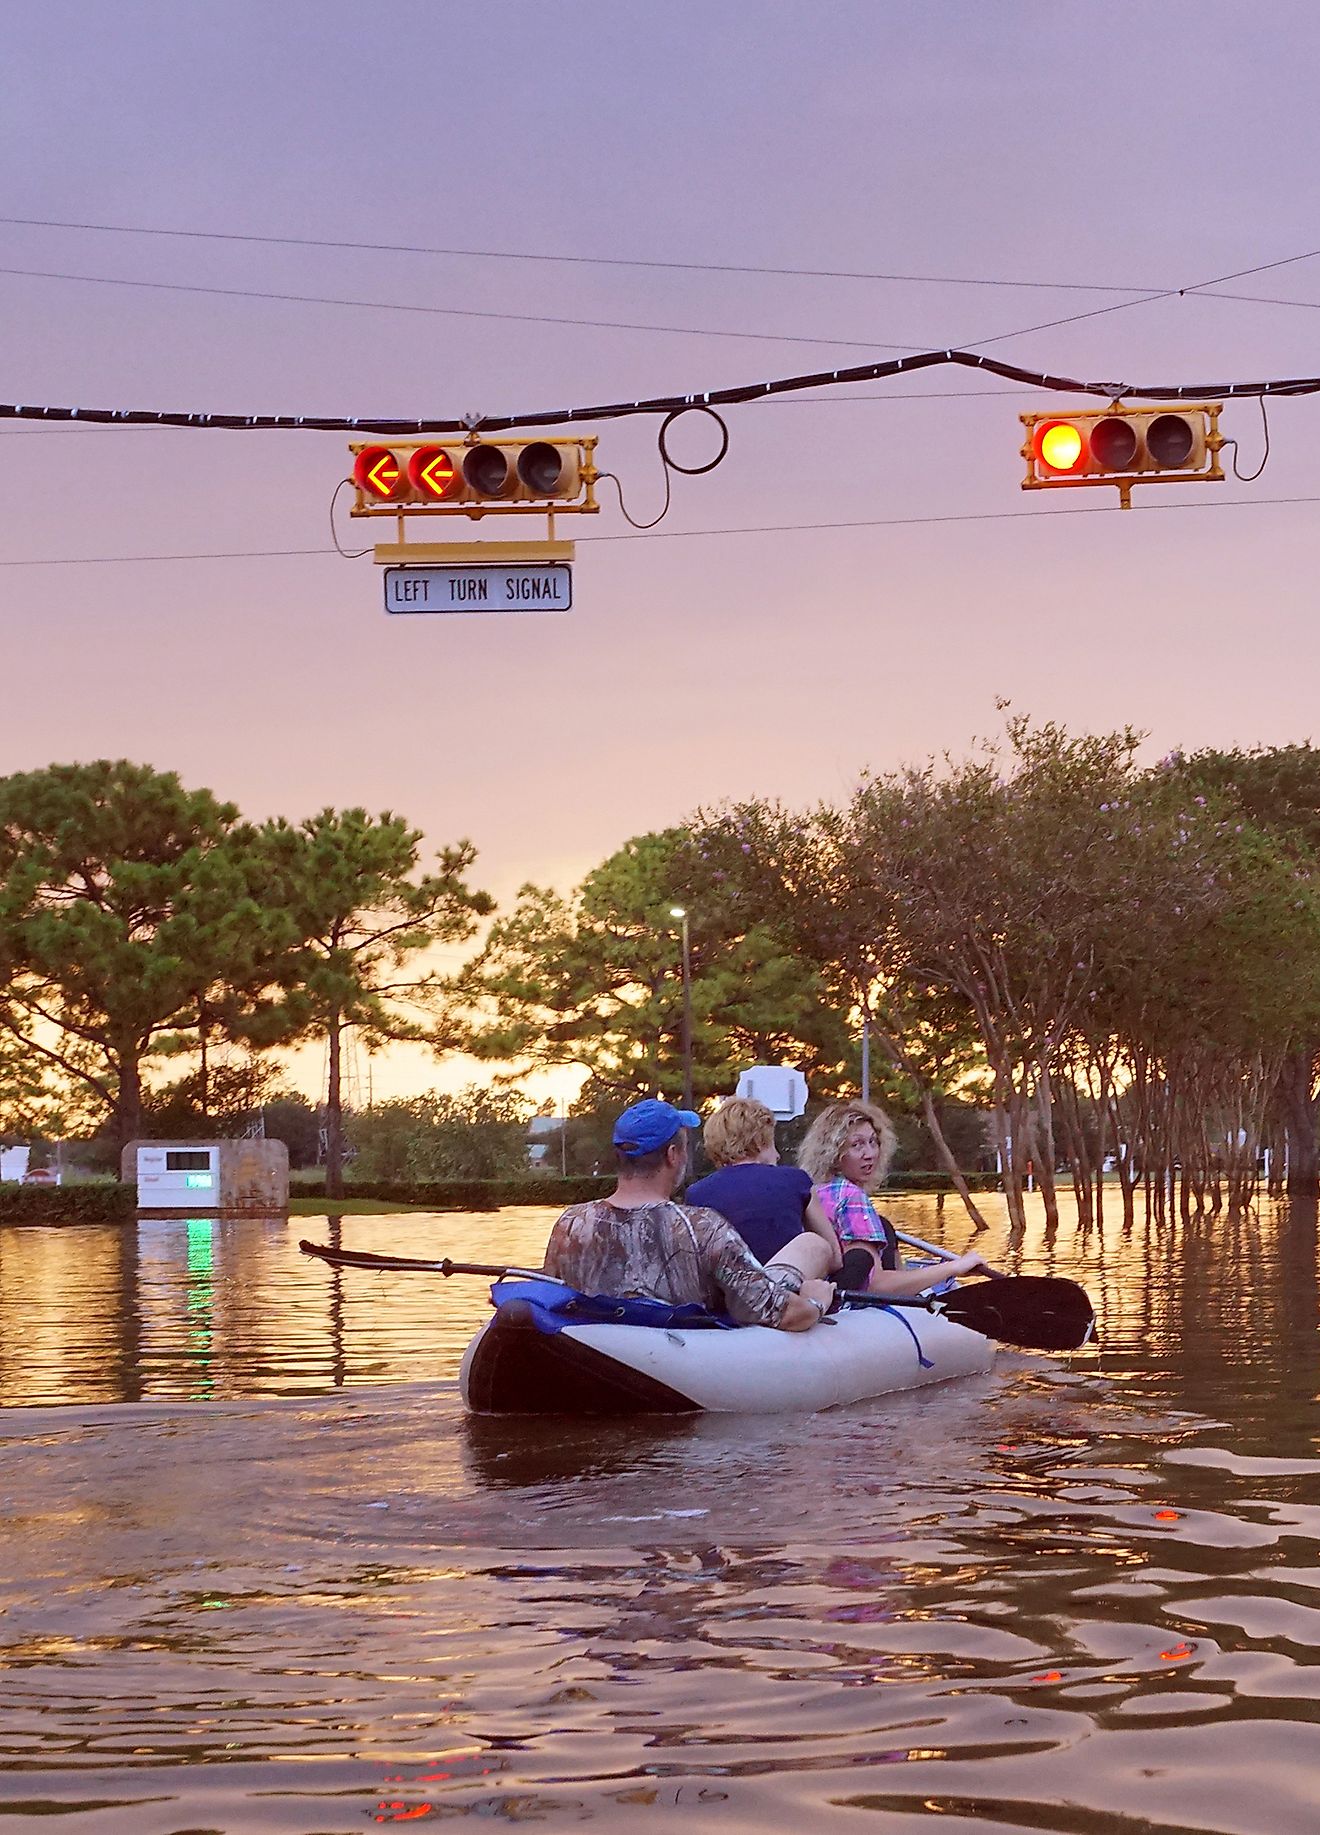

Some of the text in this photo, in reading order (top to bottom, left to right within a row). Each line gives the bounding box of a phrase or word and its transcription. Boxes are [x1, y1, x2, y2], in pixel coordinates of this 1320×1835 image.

[395, 577, 561, 602] LEFT TURN SIGNAL
